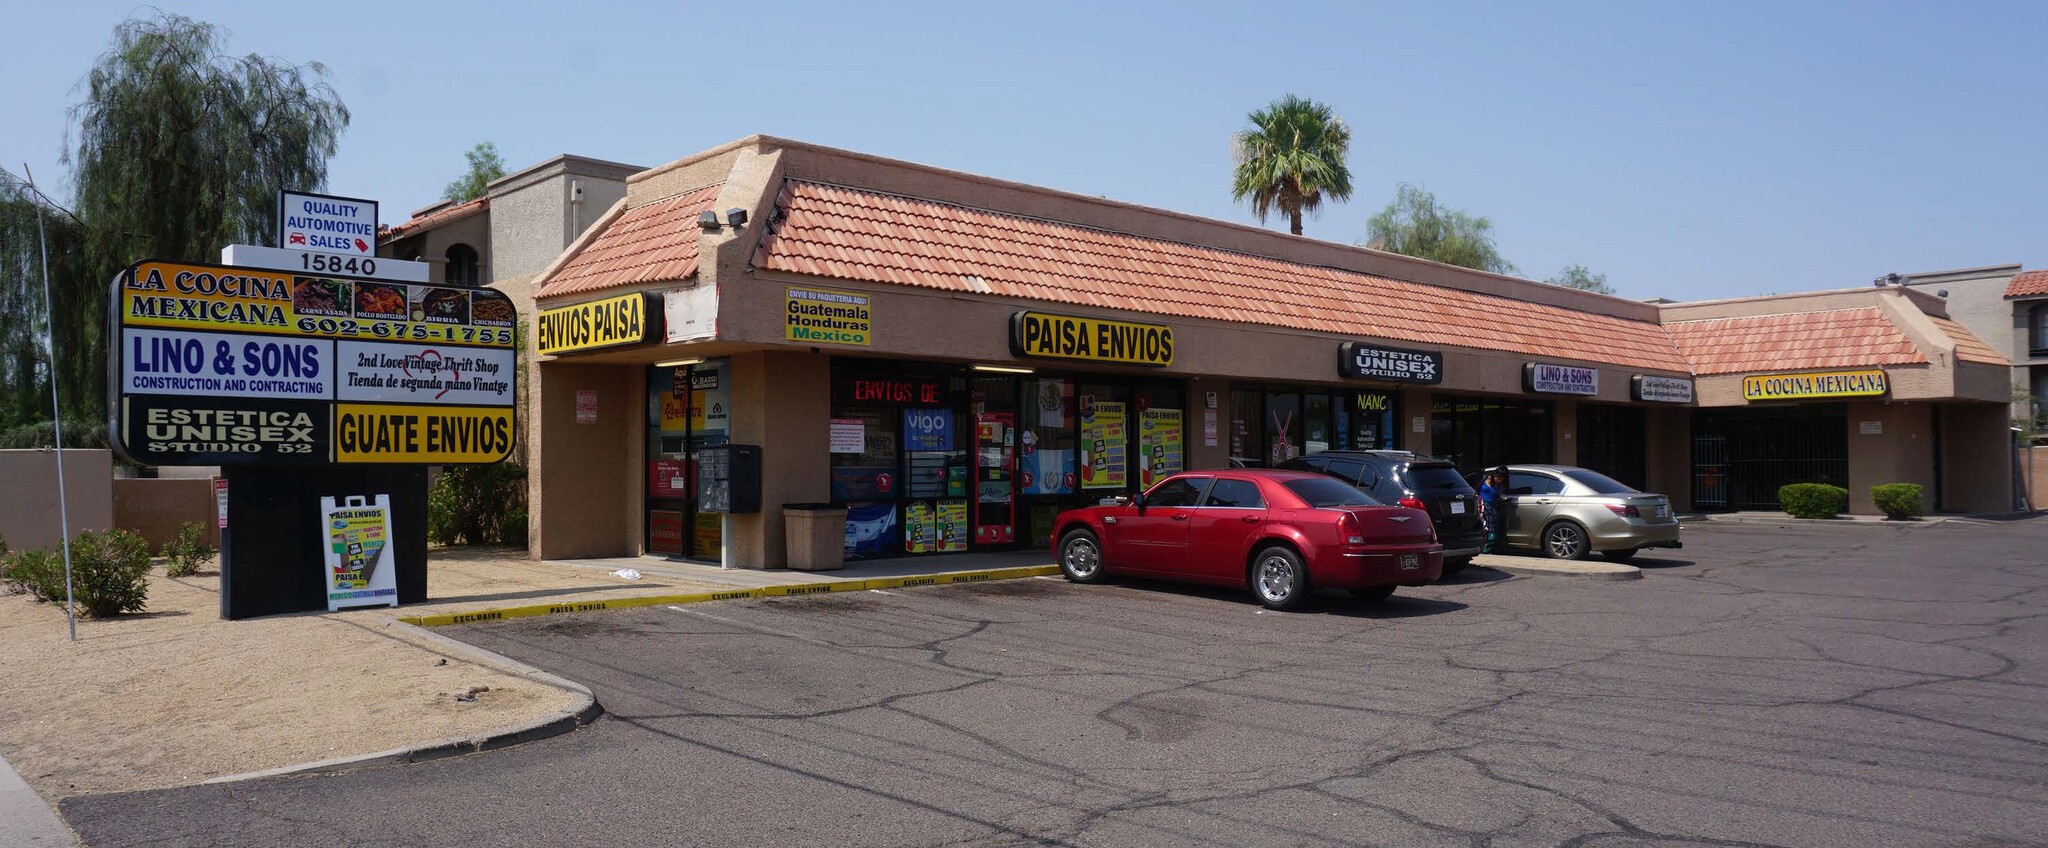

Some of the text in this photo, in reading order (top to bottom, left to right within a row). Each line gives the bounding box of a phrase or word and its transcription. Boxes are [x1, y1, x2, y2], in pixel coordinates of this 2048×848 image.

[303, 201, 358, 218] QUALITY
[287, 216, 372, 235] AUTOMOTIVE
[309, 235, 351, 250] SALES
[301, 253, 376, 276] 15840
[126, 267, 292, 301] LA COCINA
[789, 290, 867, 305] ENVIE SU PAQUETERIA AQUI
[131, 295, 288, 327] MEXICANA
[300, 307, 348, 317] CARNE ASADA
[375, 312, 407, 321] ROSTIZADO
[788, 300, 868, 320] Guatemala
[426, 316, 459, 324] BIRRIA
[474, 318, 512, 327] CHICHARRON
[538, 297, 641, 351] ENVIOS PAISA
[788, 314, 869, 331] Honduras
[297, 316, 512, 344] 602-675-1755
[793, 327, 864, 343] Mexico
[1025, 316, 1172, 363] PAISA ENVIOS
[133, 336, 320, 379] LINO & SONS
[357, 352, 499, 376] 2nd Love Vintage Thrift Shop
[1356, 355, 1436, 374] UNISEX
[1360, 348, 1432, 363] ESTETICA
[1361, 368, 1410, 378] STUDIO
[1541, 366, 1592, 384] LINO & SONS
[133, 376, 323, 394] CONSTRUCTION AND CONTRACTING
[348, 372, 508, 396] Tienda de segunda mano Vinatge
[855, 381, 941, 403] ENVIOS DE
[1747, 374, 1885, 396] LA COCINA MEXICANA
[1357, 394, 1387, 410] NANC
[148, 408, 314, 427] ESTETICA
[908, 415, 945, 433] vigo
[147, 425, 315, 442] UNISEX
[340, 413, 509, 454] GUATE ENVIOS
[148, 442, 313, 454] STUDIO 52
[354, 510, 382, 518] ENVIOS
[550, 602, 606, 614] PAISA ENVIOS
[453, 612, 502, 623] EXCLUSIVO
